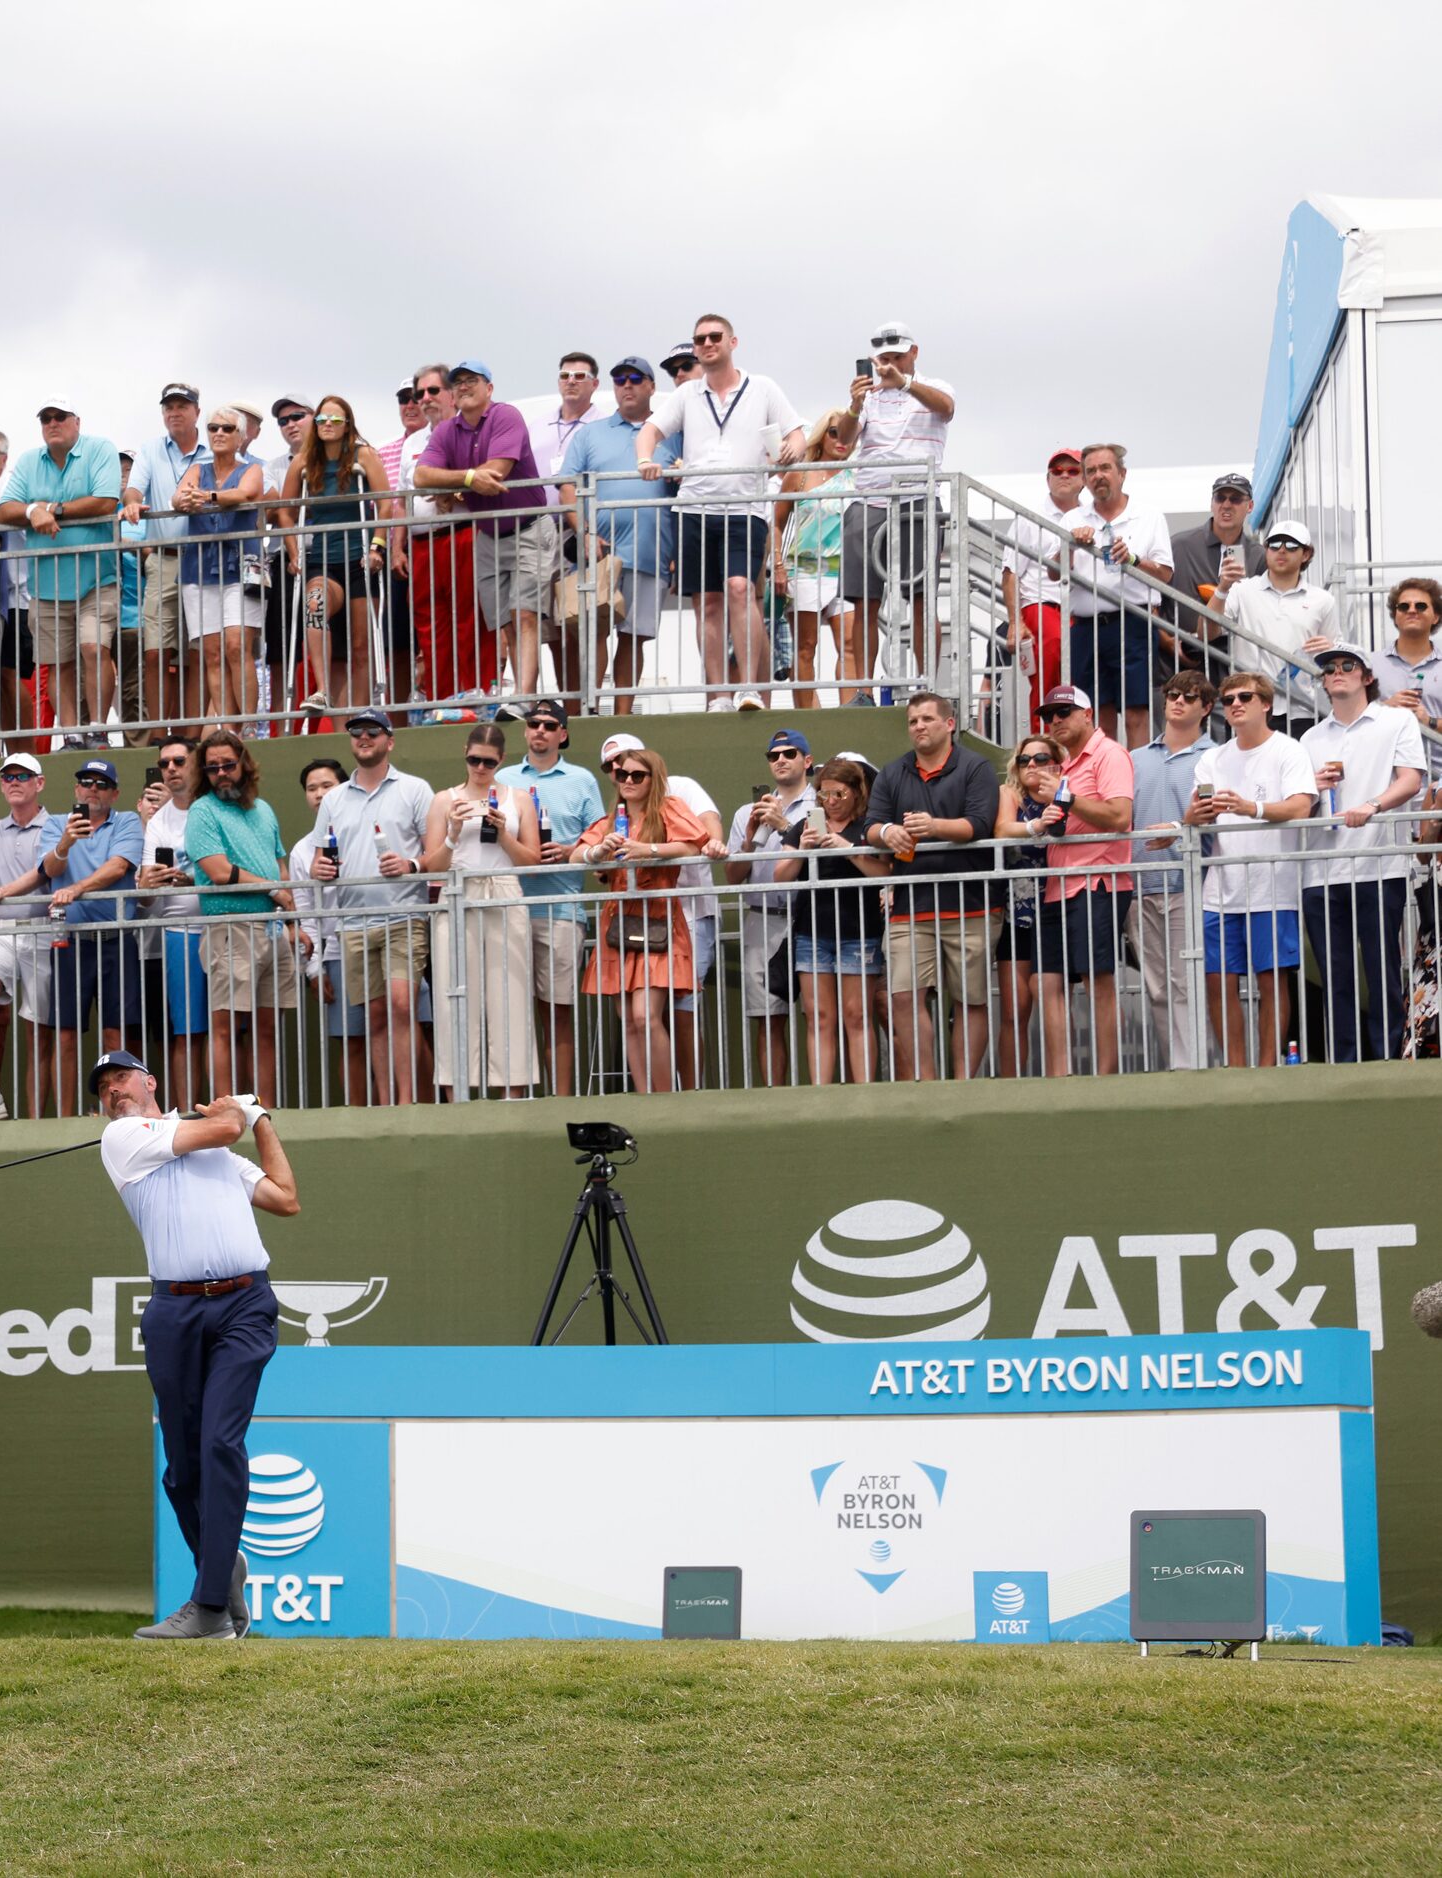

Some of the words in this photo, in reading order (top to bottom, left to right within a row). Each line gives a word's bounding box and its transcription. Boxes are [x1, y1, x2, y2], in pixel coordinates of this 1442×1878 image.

[1031, 1223, 1418, 1352] AT&T
[869, 1359, 975, 1396] AT&T
[987, 1355, 1130, 1395] BYRON
[1140, 1349, 1303, 1391] NELSON
[858, 1475, 901, 1490] AT&T
[843, 1494, 916, 1510] BYRON
[837, 1513, 923, 1529] NELSON
[1150, 1565, 1244, 1575] TRACKMAN
[245, 1574, 344, 1623] T&T
[989, 1620, 1030, 1634] AT&T
